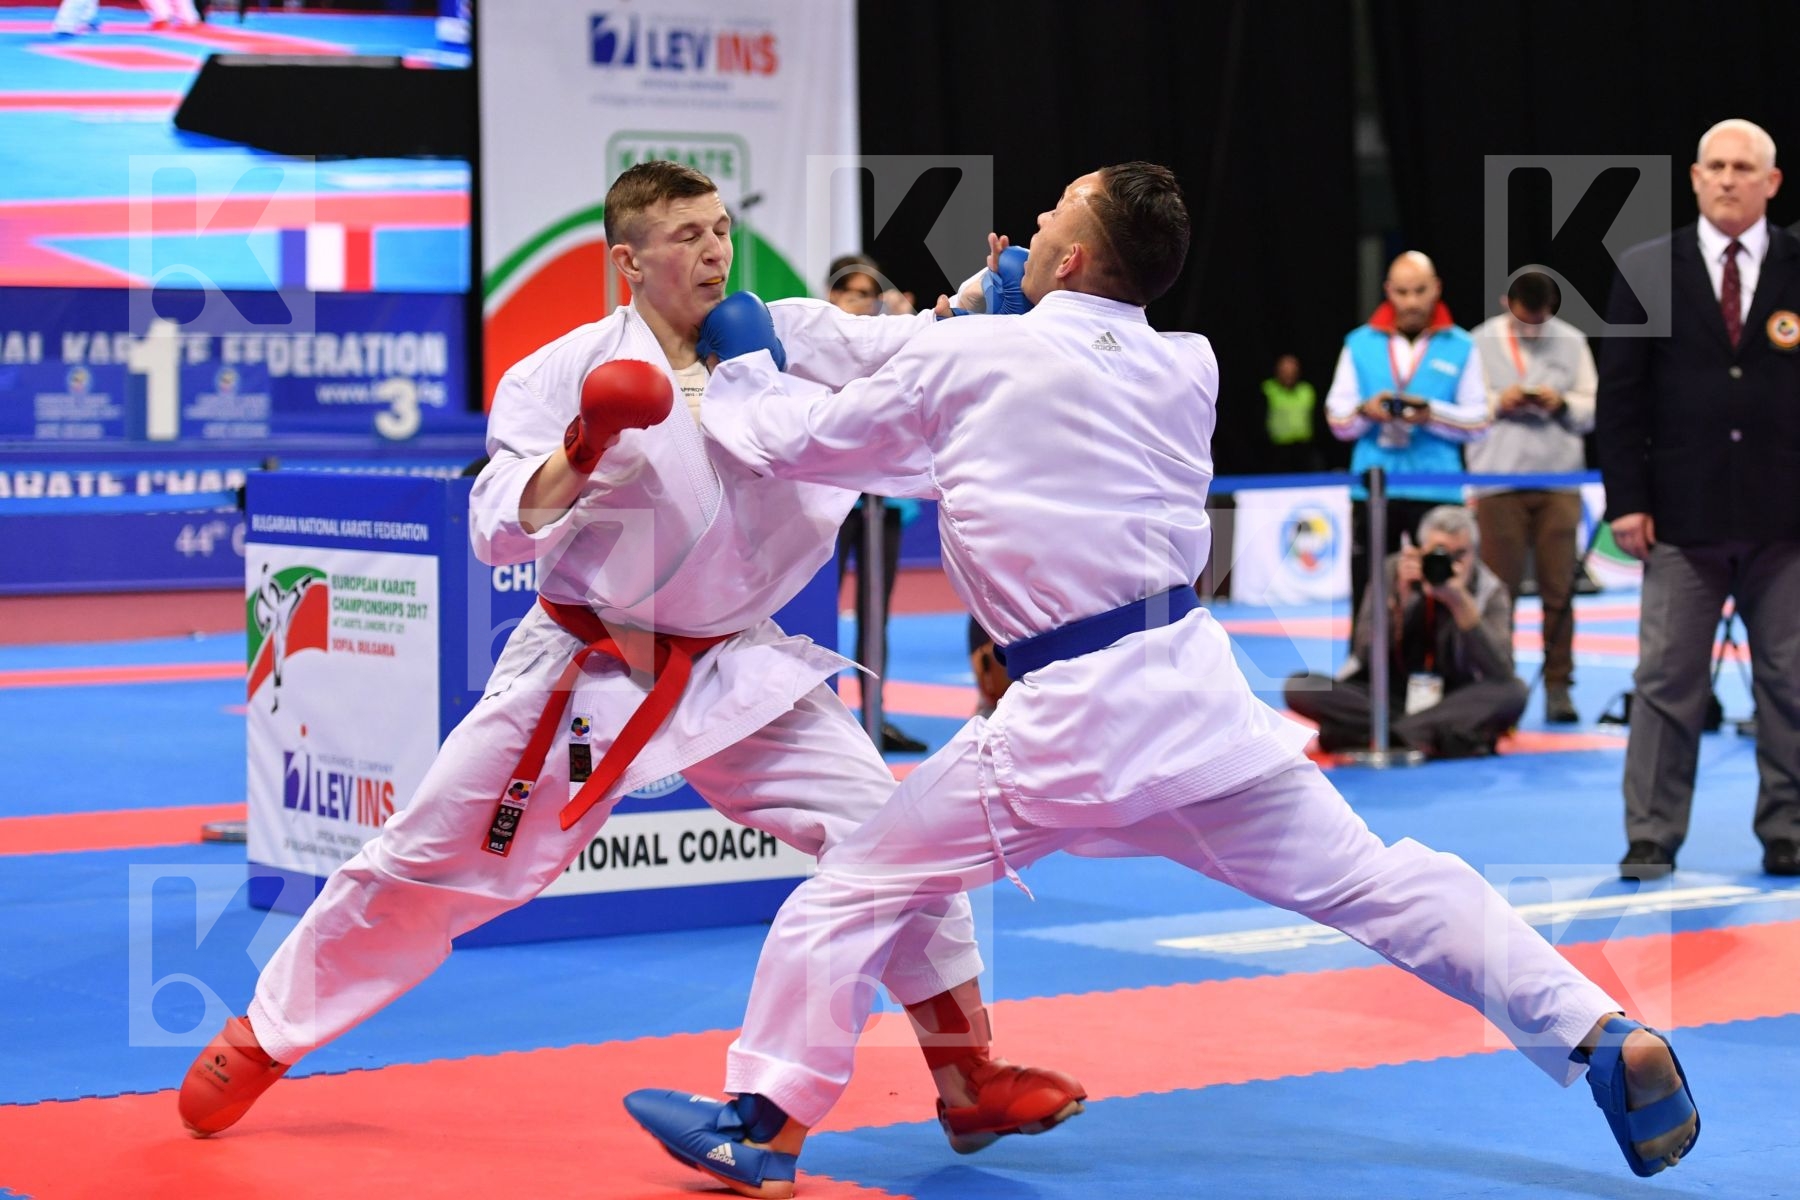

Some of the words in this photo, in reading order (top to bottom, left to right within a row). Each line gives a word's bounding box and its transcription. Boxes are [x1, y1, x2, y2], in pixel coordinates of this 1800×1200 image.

[222, 332, 449, 377] FEDERATION
[1091, 344, 1121, 352] adidas
[129, 318, 179, 440] 1
[374, 377, 421, 440] 3
[252, 514, 297, 532] BULGARIAN
[299, 516, 338, 536] NATIONAL
[340, 519, 373, 538] KARATE
[374, 521, 429, 541] FEDERATION
[332, 574, 378, 593] EUROPEAN
[382, 578, 416, 597] KARATE
[333, 596, 404, 617] CHAMPIONSHIPS
[407, 603, 428, 619] 2017
[316, 770, 352, 821] LEV
[565, 832, 667, 872] IONAL
[679, 828, 777, 863] COACH
[707, 1152, 735, 1167] adidas
